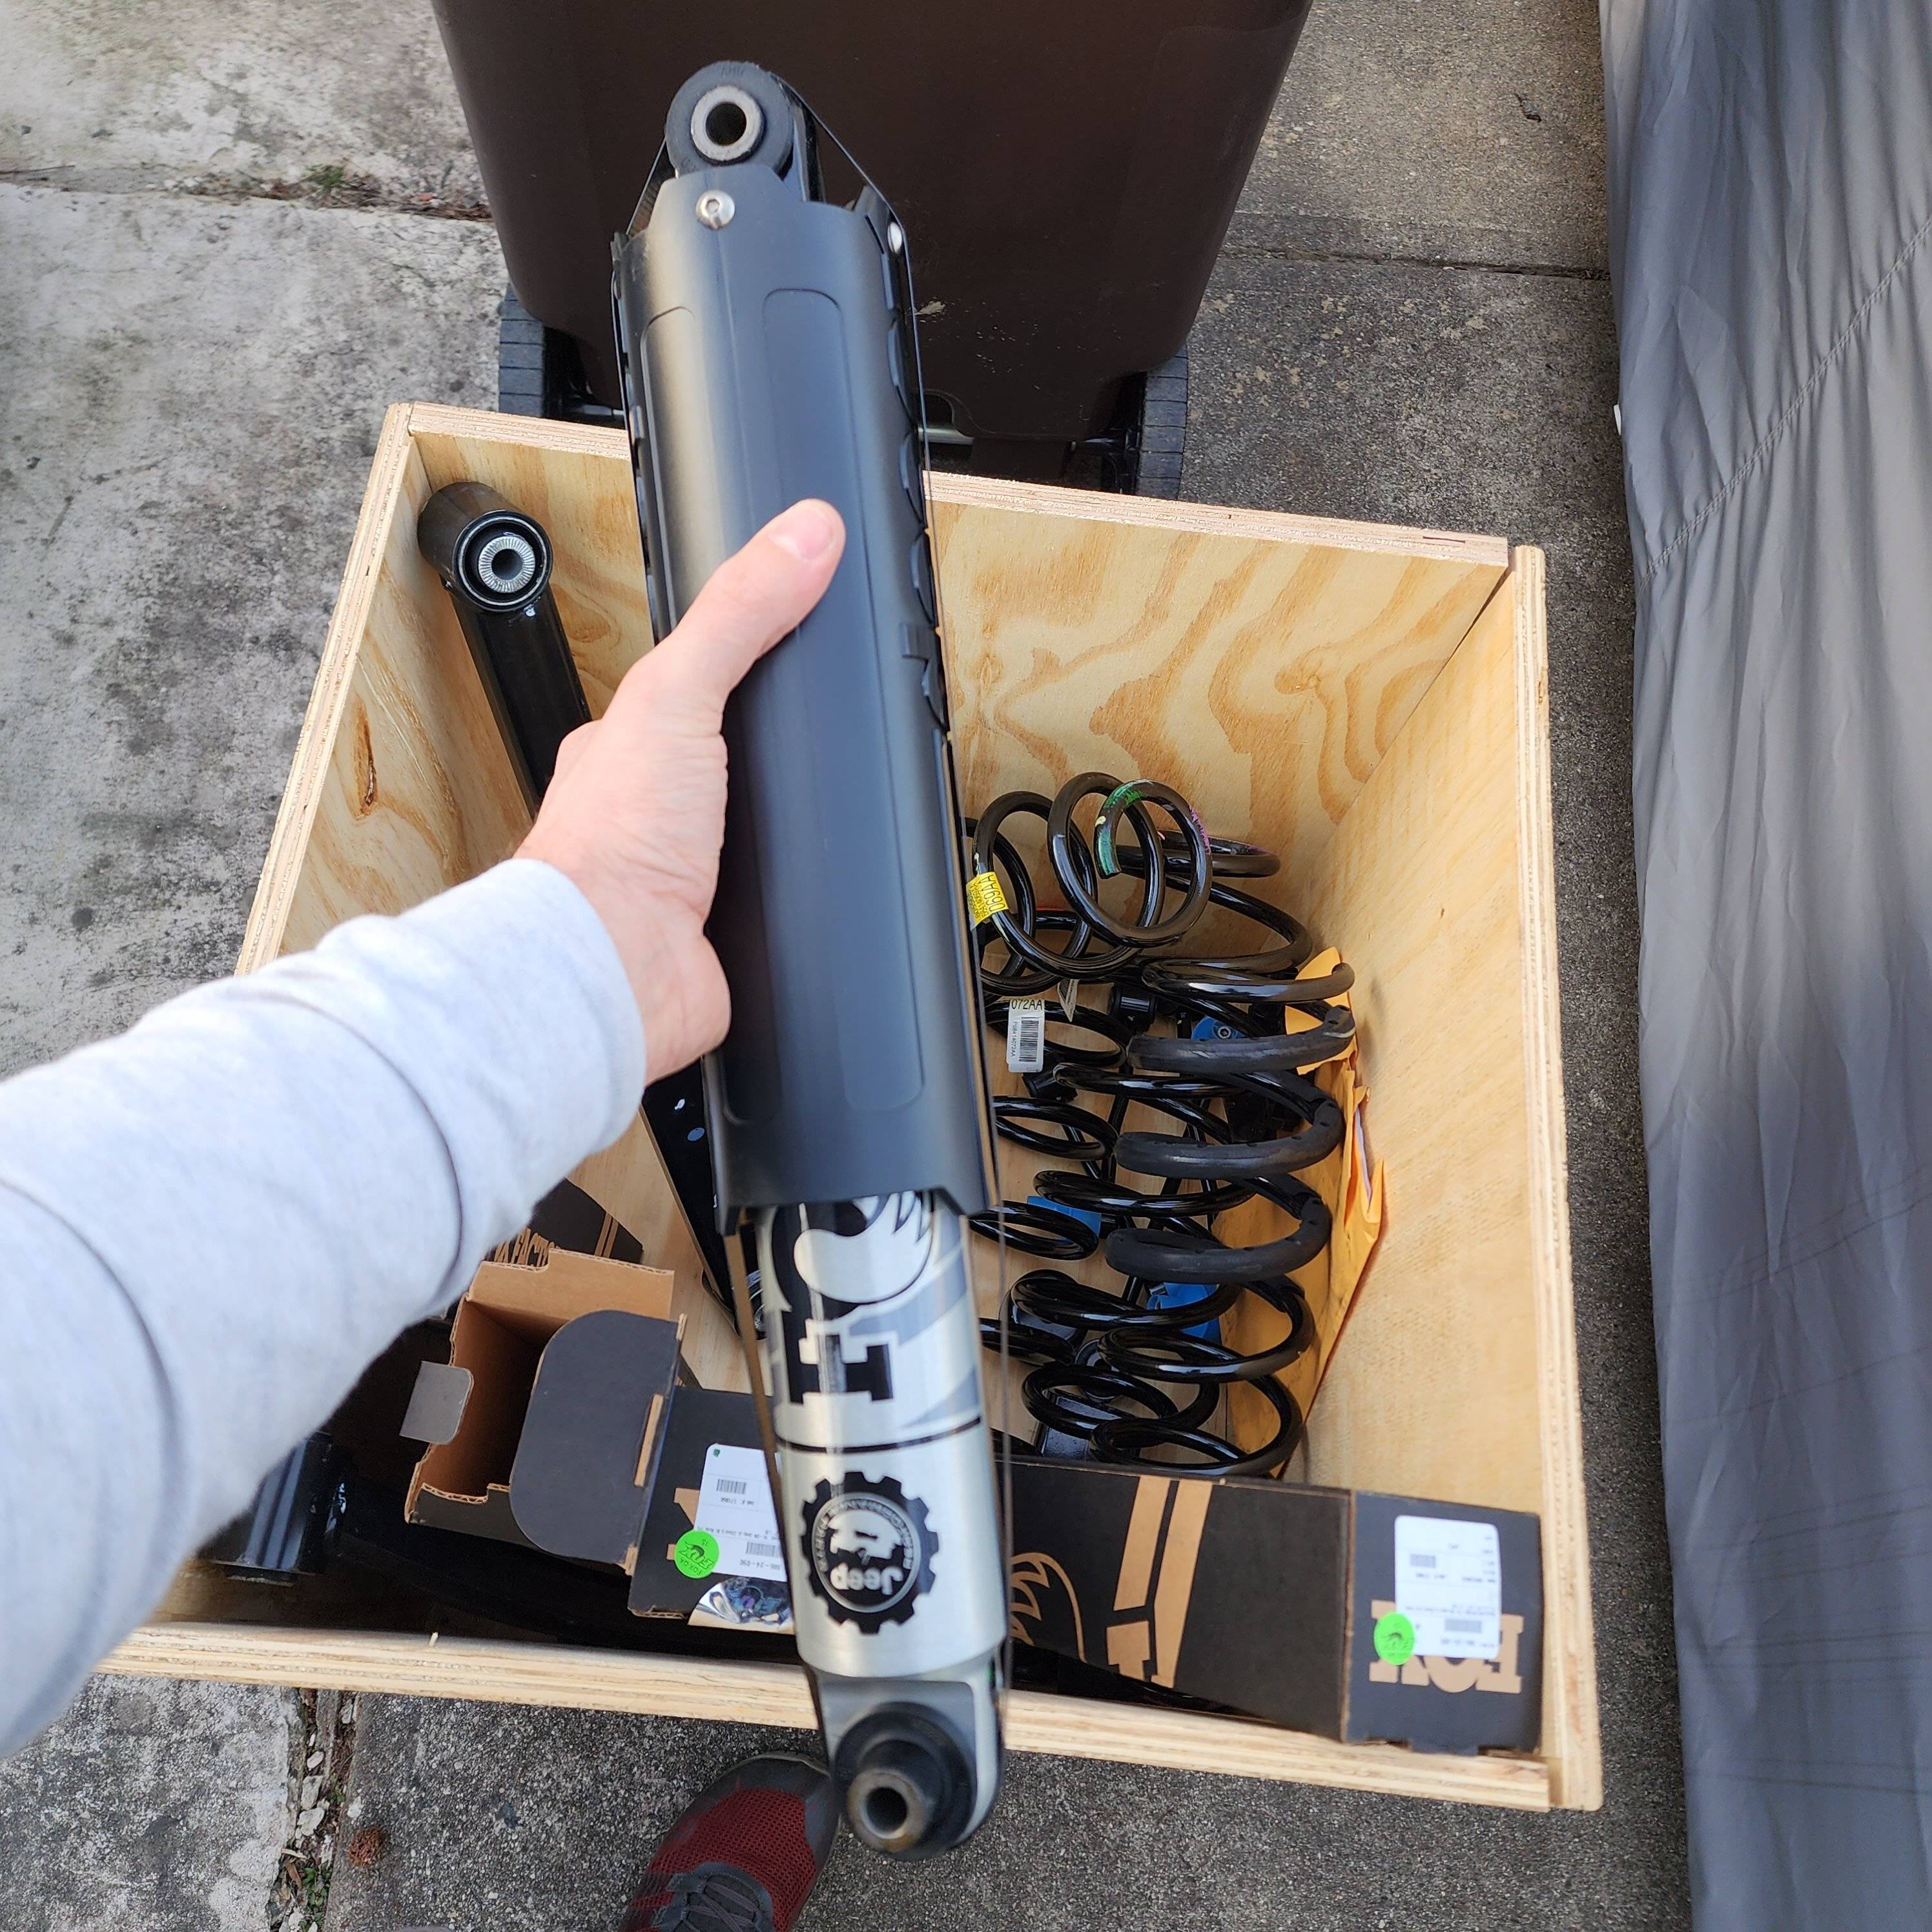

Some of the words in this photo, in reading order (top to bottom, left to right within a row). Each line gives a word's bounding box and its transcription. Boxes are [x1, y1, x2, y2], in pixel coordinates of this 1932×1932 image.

[979, 874, 1005, 912] 069AA
[1011, 998, 1043, 1011] 072AA
[829, 1561, 904, 1596] Jeep
